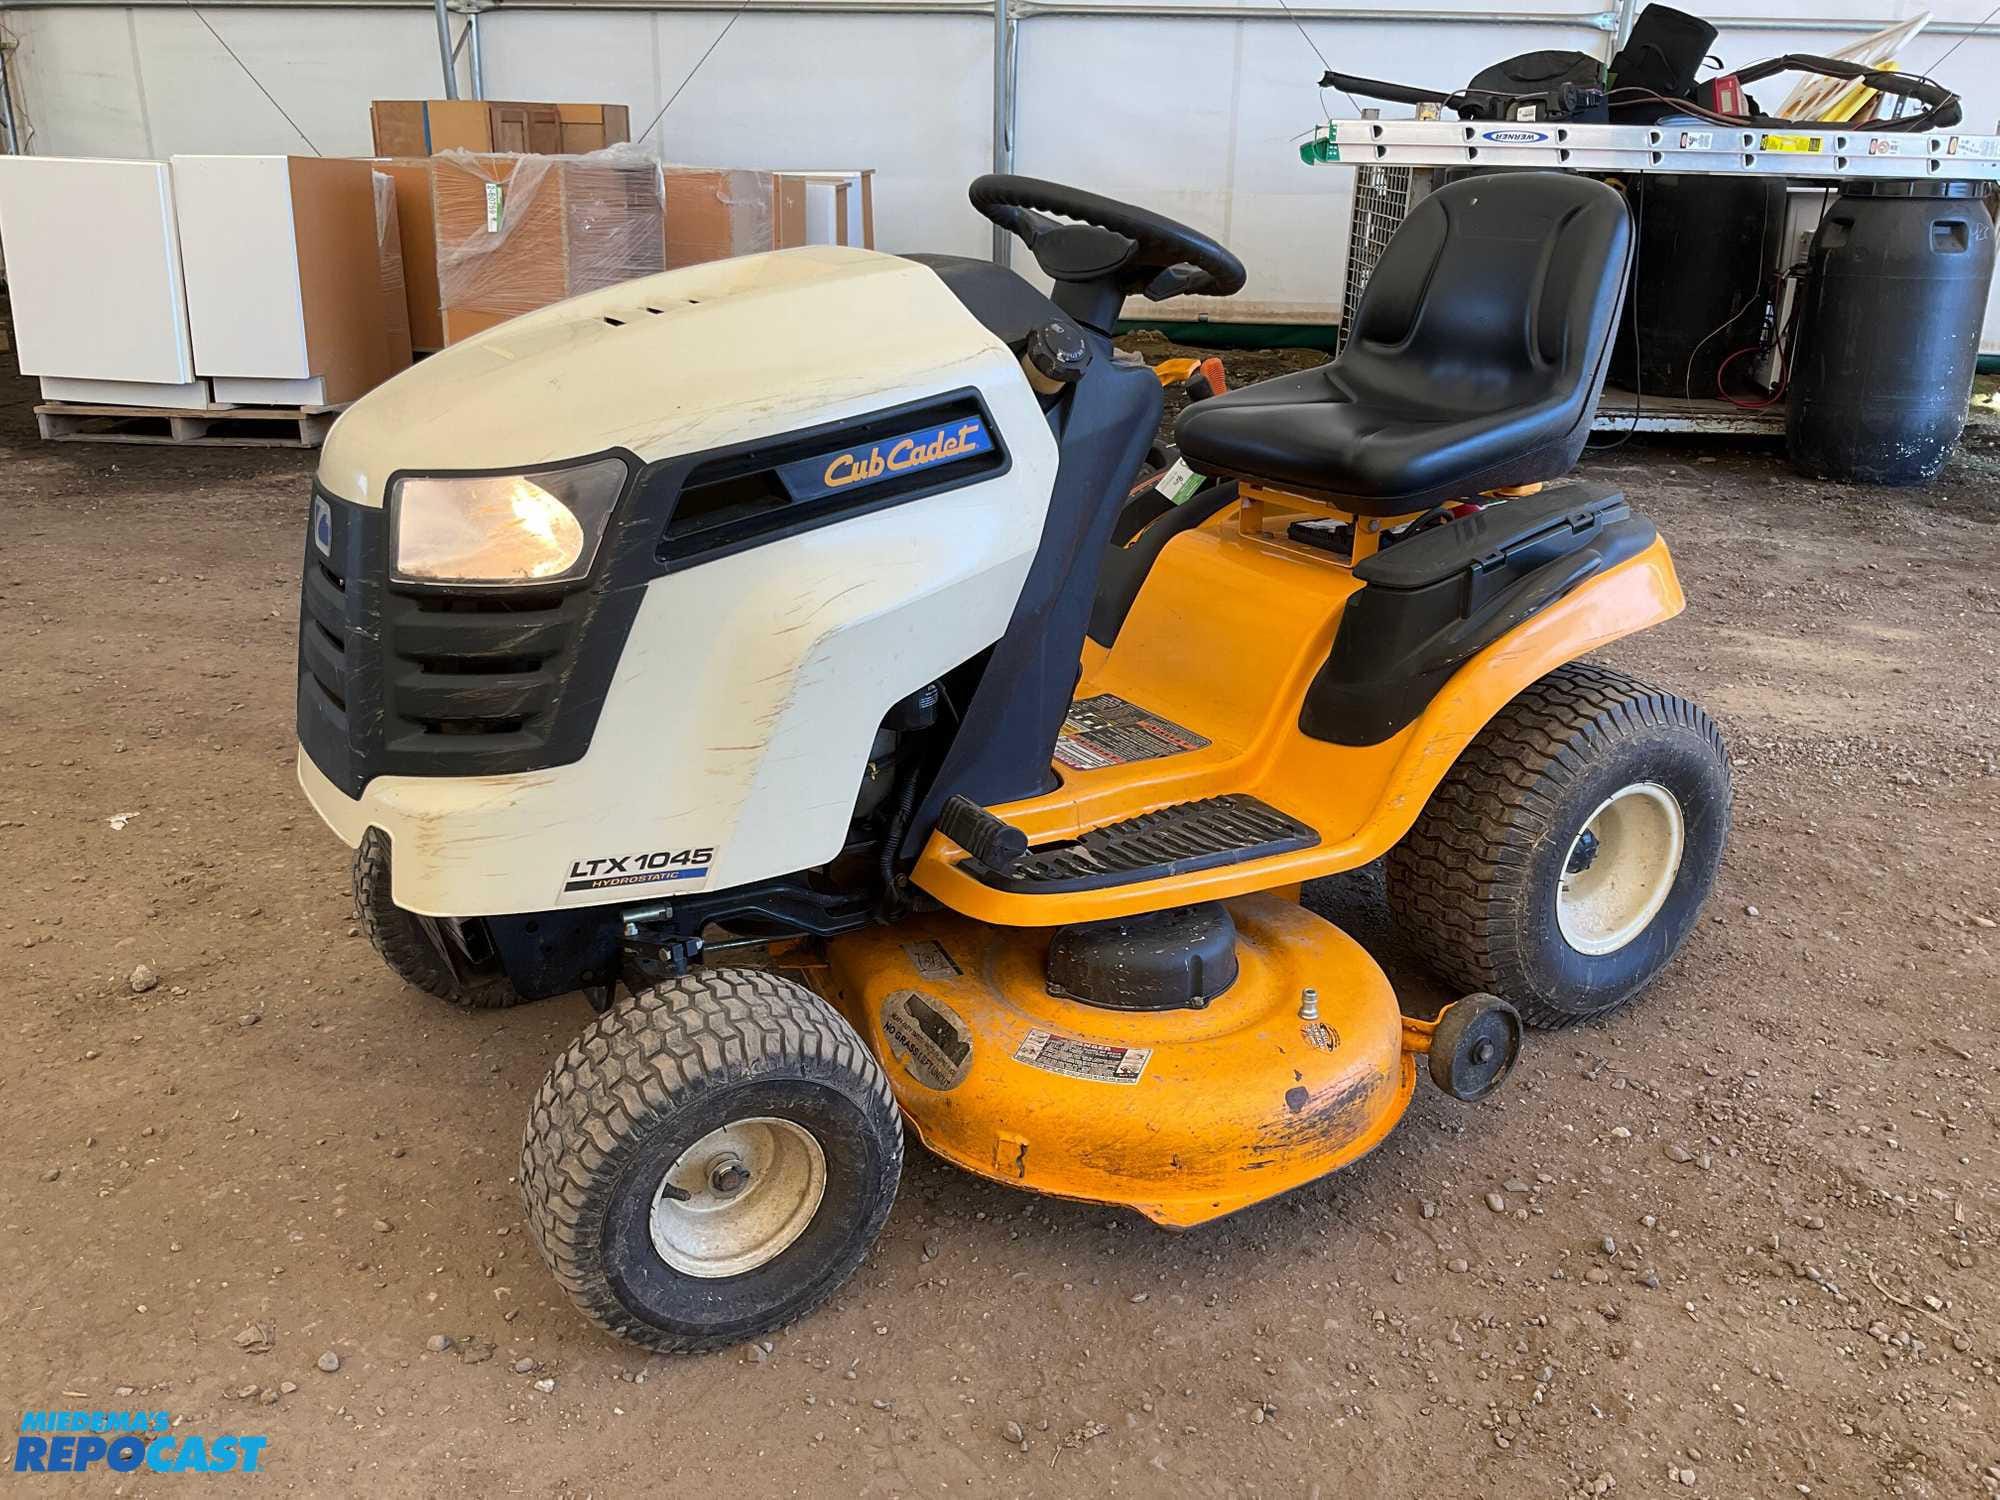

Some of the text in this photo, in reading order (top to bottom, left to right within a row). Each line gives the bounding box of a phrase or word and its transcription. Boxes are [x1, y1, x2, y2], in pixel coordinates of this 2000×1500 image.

[824, 424, 980, 488] Cub Cadet
[569, 847, 715, 878] LTX 1045
[591, 871, 680, 889] HYDROSTATIC
[883, 1020, 896, 1034] NO
[895, 1031, 920, 1057] GRASS
